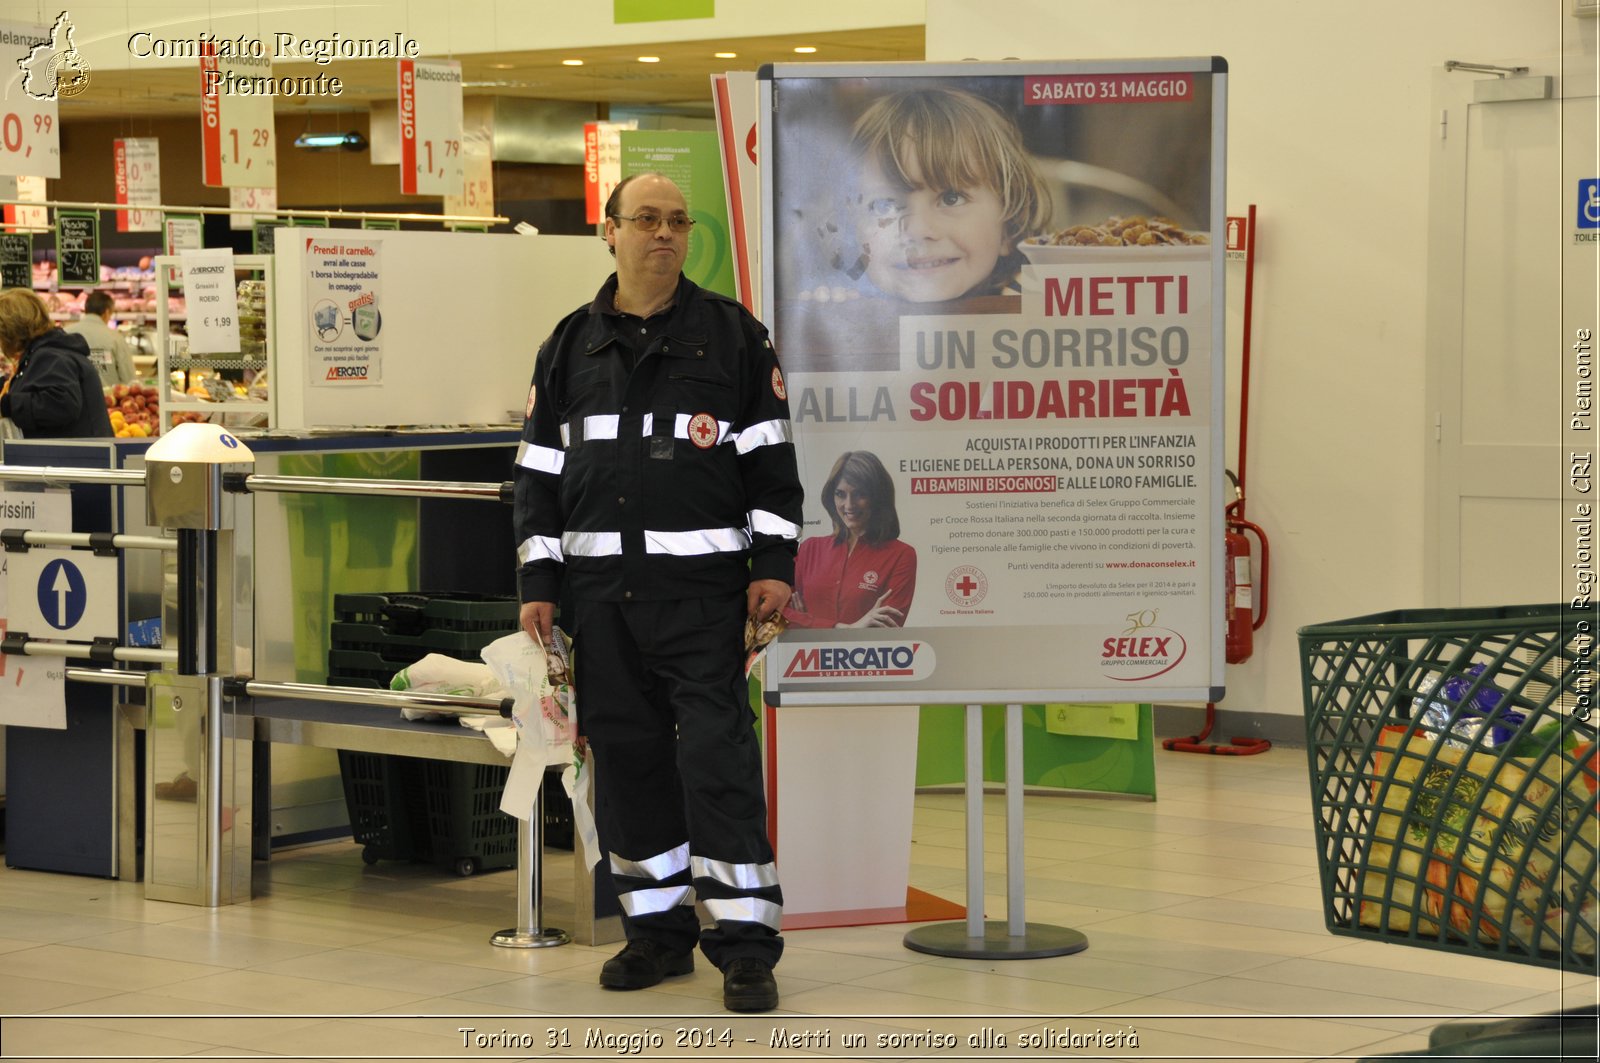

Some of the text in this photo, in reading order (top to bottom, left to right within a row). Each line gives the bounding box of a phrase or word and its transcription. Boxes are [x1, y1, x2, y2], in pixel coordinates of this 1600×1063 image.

[0, 30, 52, 47] elanzan
[416, 68, 461, 82] Albicocche
[1032, 80, 1187, 100] SABATO 31 MAGGIO
[402, 71, 414, 140] offerta
[586, 132, 598, 184] offerta
[116, 148, 126, 194] offerta
[1574, 233, 1600, 242] TOILE
[314, 245, 375, 256] Prendi il carrello,
[334, 271, 378, 280] biodegradabile
[348, 291, 374, 312] gratis!
[1044, 275, 1188, 316] METTI
[204, 317, 231, 328] € 1,99
[916, 326, 1190, 370] UN SORRISO
[795, 368, 1191, 422] ALLA SOLIDARIETÀ
[966, 435, 1196, 454] ACQUISTA I PRODOTTI PER L'INFANZIA
[900, 455, 1196, 472] E L'IGIENE DELLA PERSONA, DONA UN SORRISO
[914, 475, 1197, 492] AI BAMBINI BISOGNOSI E ALLE LORO FAMIGLIE.
[0, 502, 35, 520] rissini
[966, 500, 998, 509] Sostieni
[1040, 499, 1075, 508] benefica
[1076, 499, 1085, 507] di
[1110, 498, 1140, 508] Gruppo
[1142, 498, 1196, 506] Commerciale
[930, 517, 944, 526] per
[946, 516, 968, 524] Croce
[994, 515, 1024, 523] Italiana
[1026, 514, 1046, 522] nella
[1048, 514, 1082, 522] seconda
[1082, 514, 1117, 523] giornata
[1118, 513, 1126, 521] di
[1128, 512, 1162, 521] raccolta.
[1164, 512, 1196, 520] Insieme
[949, 531, 984, 540] potremo
[986, 530, 1014, 538] donare
[1016, 529, 1048, 537] 300.000
[1050, 529, 1070, 538] pasti
[1078, 528, 1110, 536] 150.000
[1112, 528, 1145, 538] prodotti
[1147, 528, 1160, 537] per
[1162, 527, 1169, 535] la
[962, 544, 1001, 554] personale
[1003, 544, 1018, 552] alle
[1019, 544, 1052, 553] famiglie
[1054, 543, 1068, 551] che
[1070, 542, 1097, 550] vivono
[1108, 542, 1150, 550] condizioni
[1152, 541, 1160, 549] di
[1008, 562, 1028, 570] Punti
[1030, 562, 1059, 570] vendita
[1060, 561, 1093, 569] aderenti
[1106, 560, 1196, 569] www.donaconselex.it
[1102, 637, 1172, 658] SELEX
